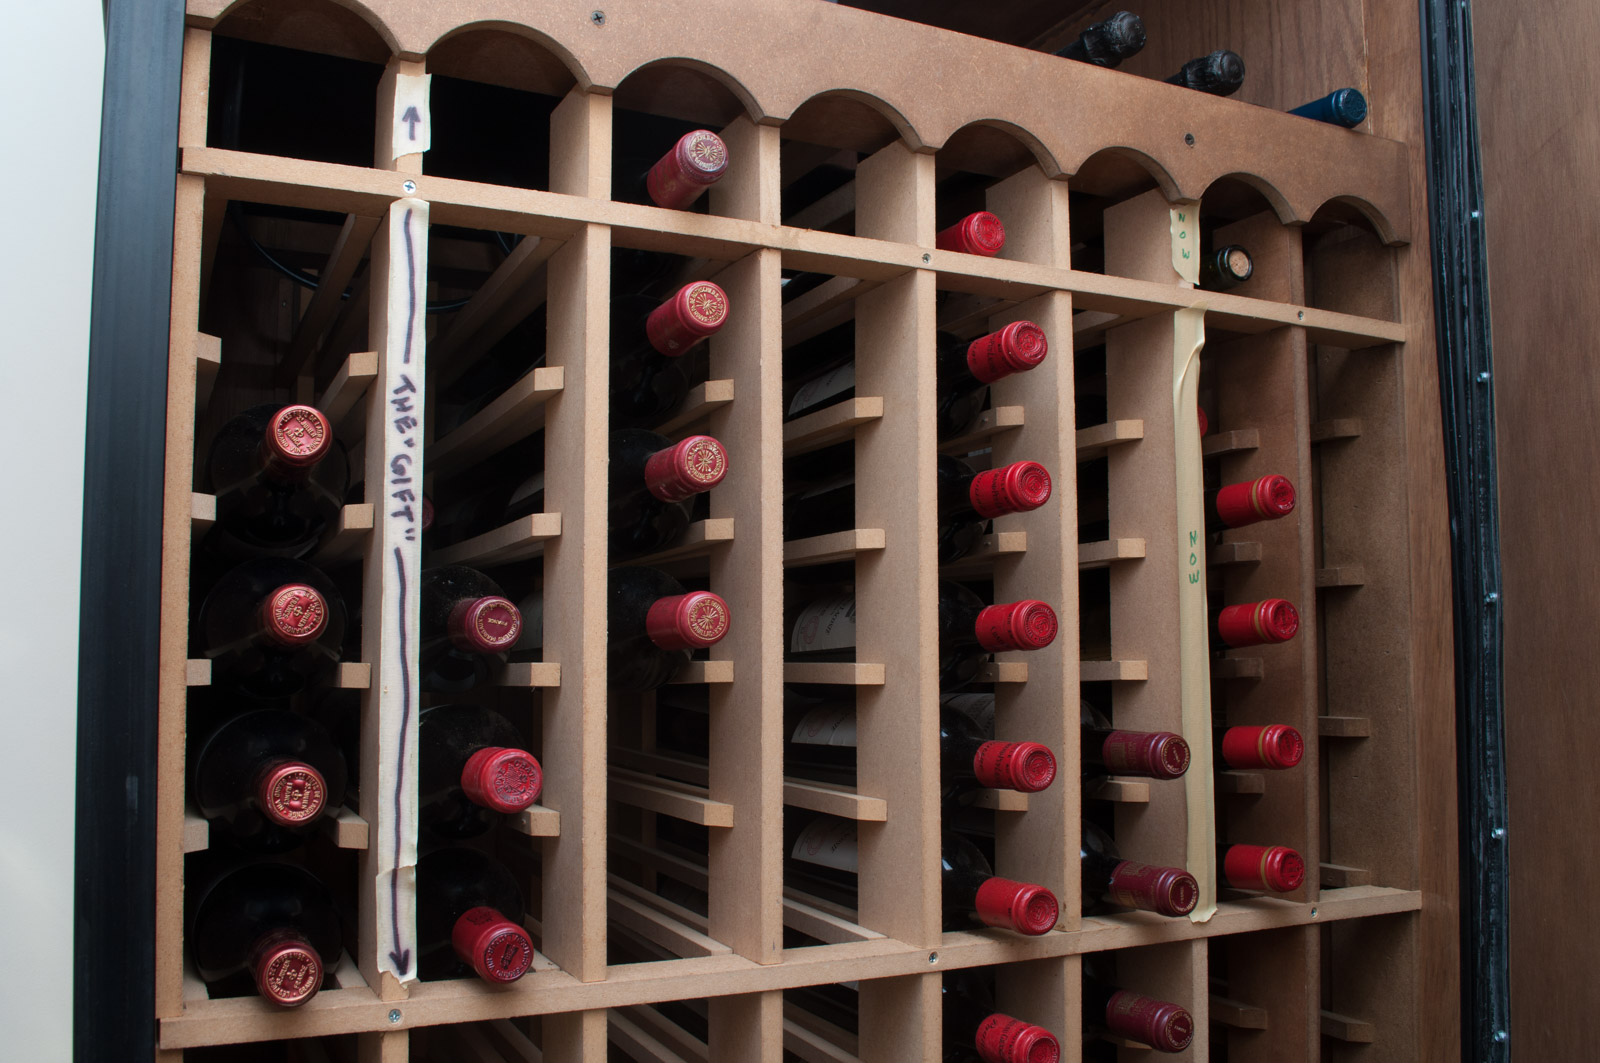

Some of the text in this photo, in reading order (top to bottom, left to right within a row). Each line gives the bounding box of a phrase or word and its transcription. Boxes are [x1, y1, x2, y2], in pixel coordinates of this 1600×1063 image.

[1178, 212, 1191, 260] NOW
[390, 374, 418, 541] THE "GIFT"
[1188, 530, 1200, 585] NOW
